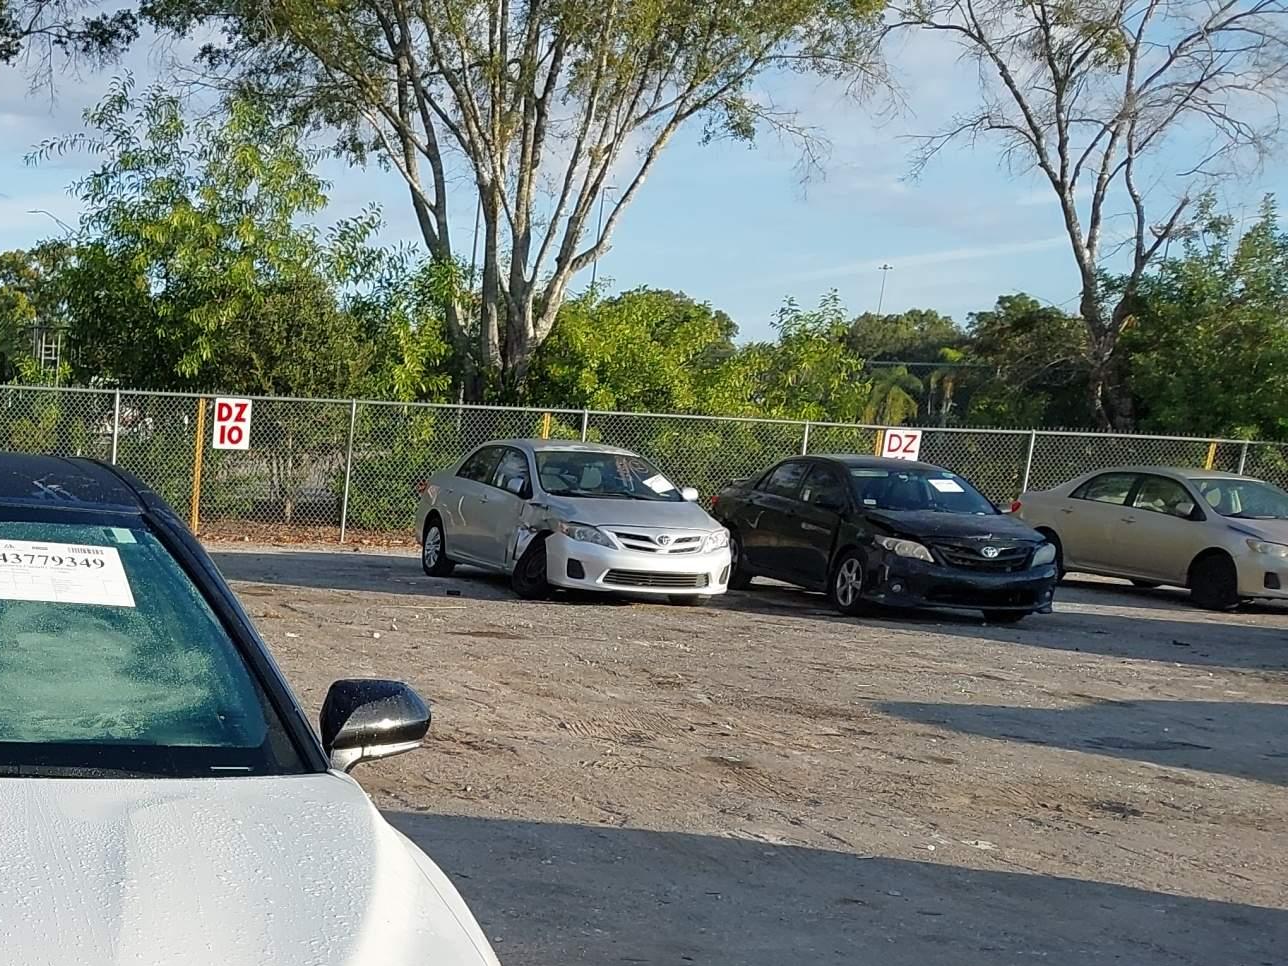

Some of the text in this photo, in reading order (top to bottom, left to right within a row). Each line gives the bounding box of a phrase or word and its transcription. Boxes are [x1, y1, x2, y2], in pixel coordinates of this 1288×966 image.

[217, 402, 248, 422] DZ
[219, 425, 243, 445] 10
[887, 433, 918, 453] DZ
